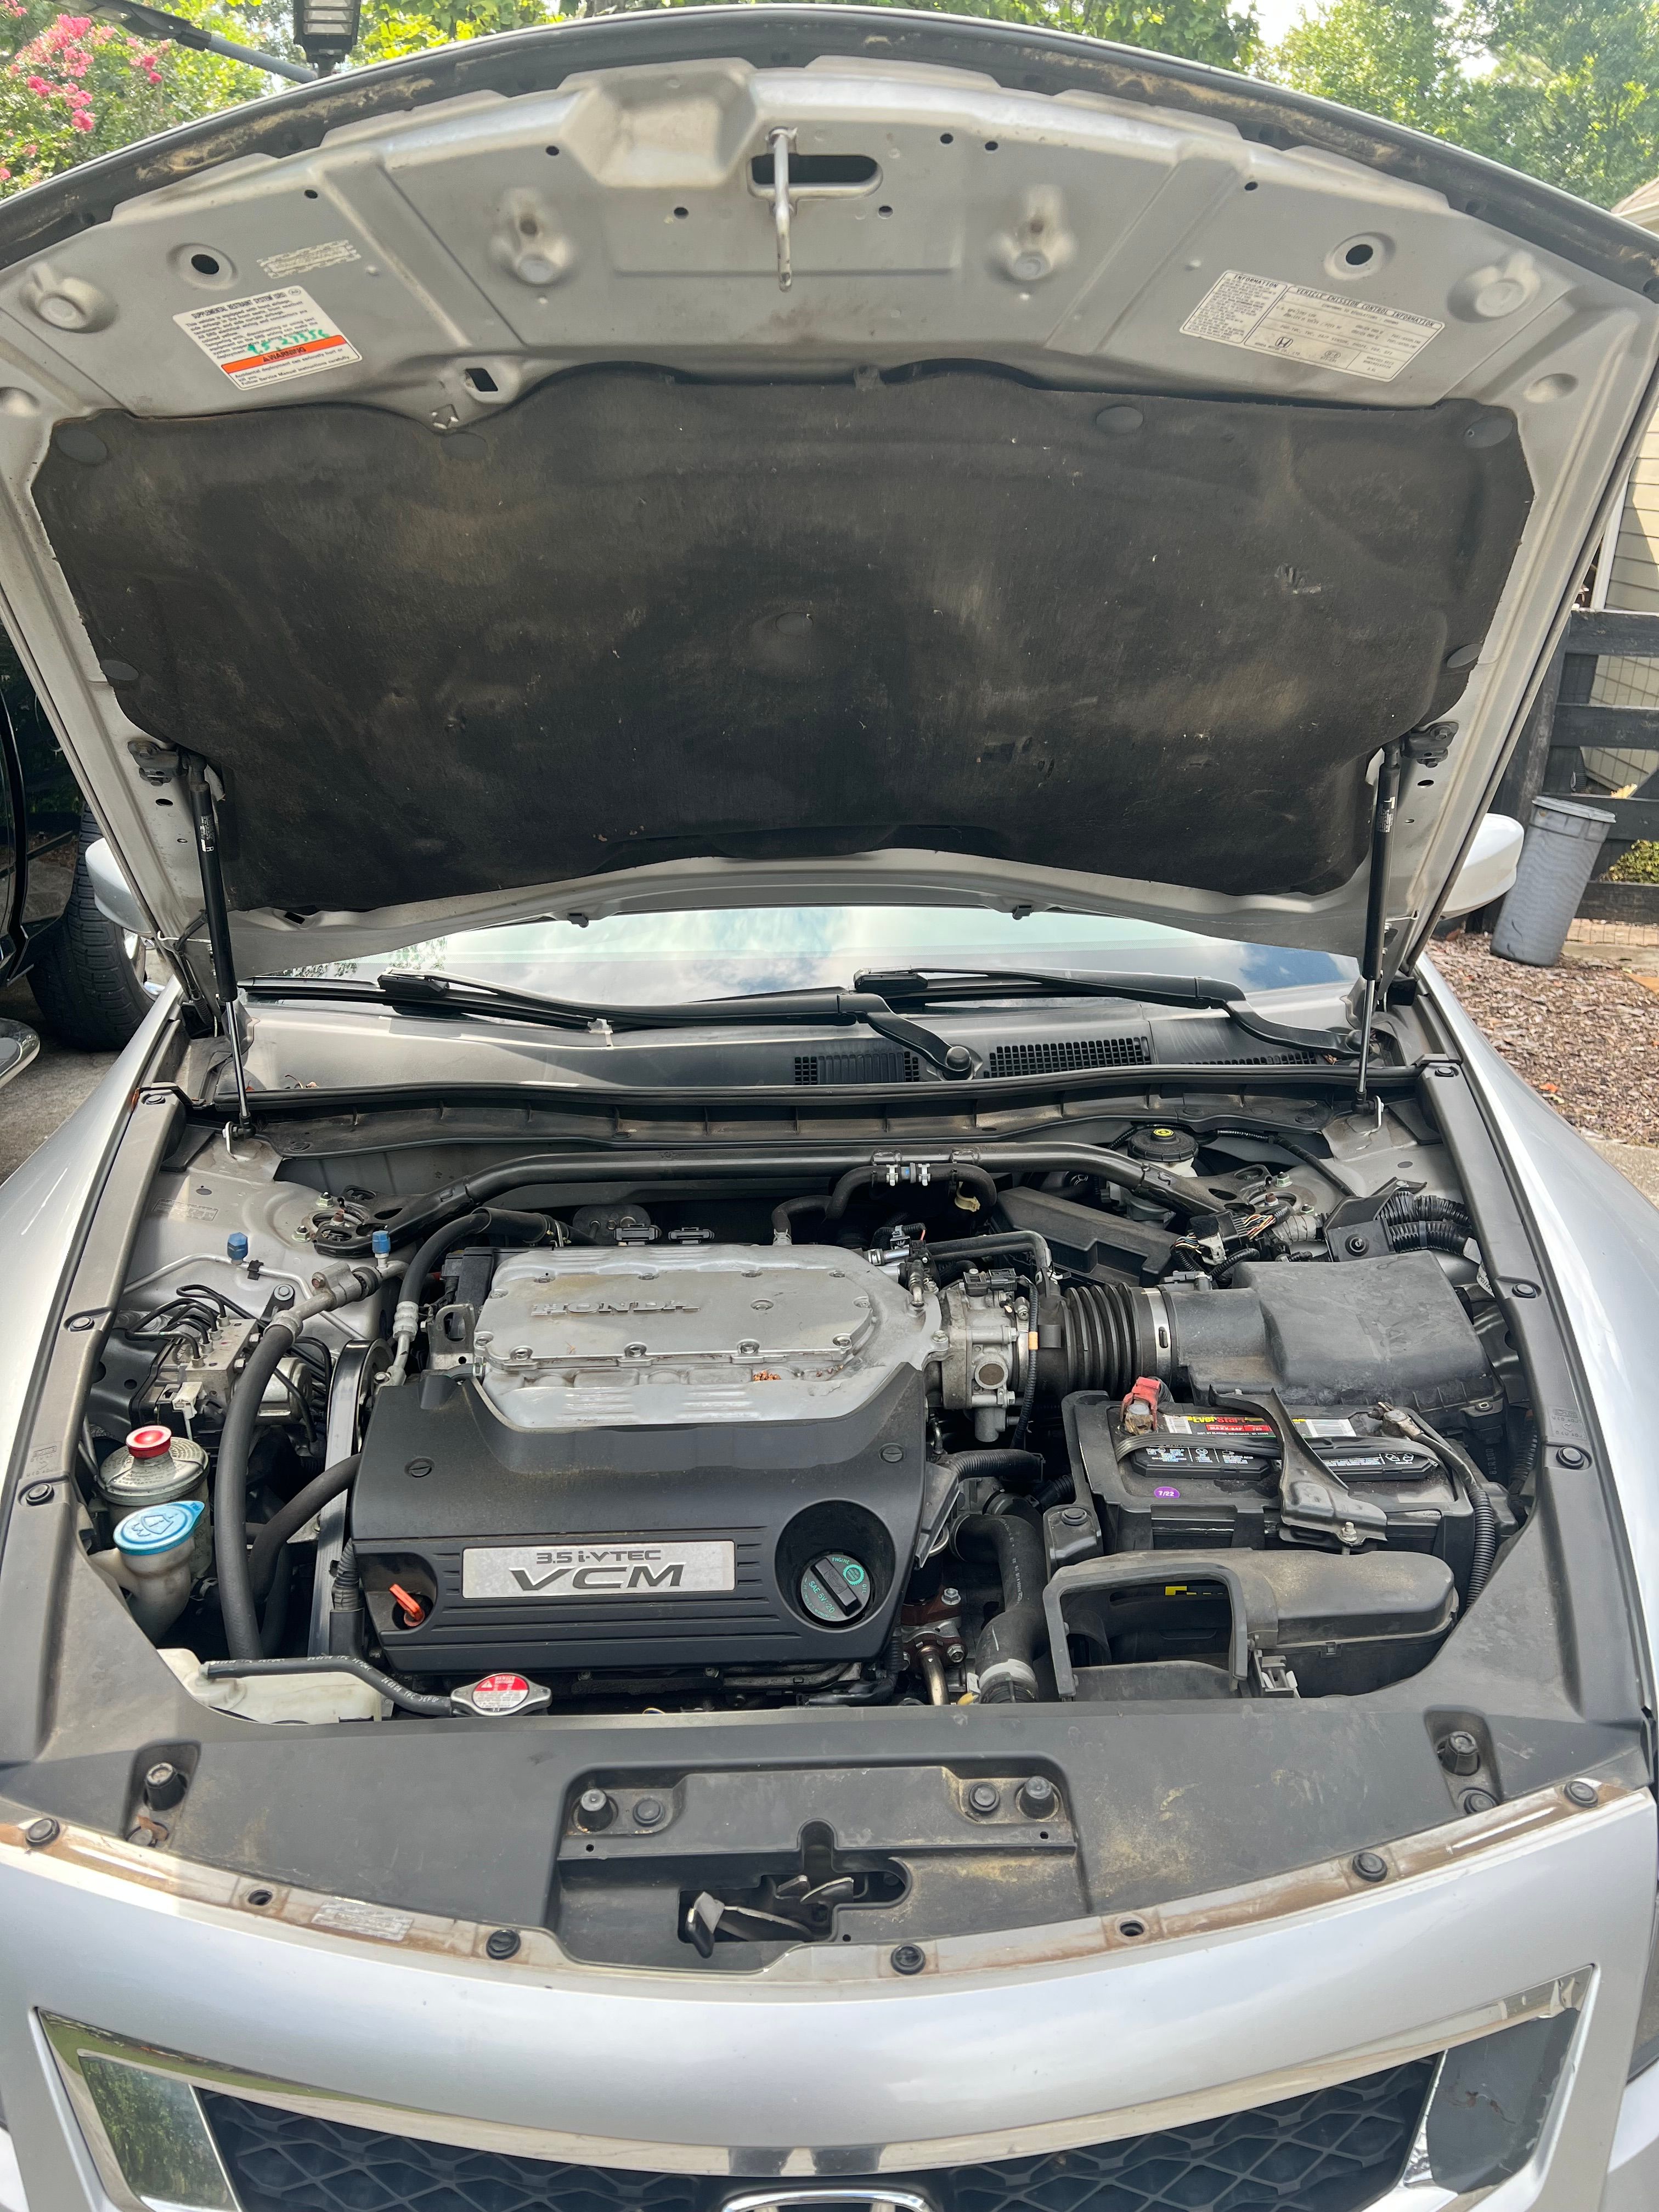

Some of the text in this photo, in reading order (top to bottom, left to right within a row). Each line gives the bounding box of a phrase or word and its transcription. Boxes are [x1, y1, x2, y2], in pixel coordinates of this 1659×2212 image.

[1234, 274, 1278, 288] INFORMATION
[1296, 288, 1323, 299] VEHICLE
[1361, 303, 1388, 316] CONTROL
[1391, 310, 1436, 328] INFORMATION
[268, 347, 307, 360] WARNING
[531, 1301, 700, 1317] HONDA
[537, 1550, 661, 1564] 3.5 i-VTEC
[509, 1562, 686, 1592] VCM
[809, 1581, 821, 1594] SAE
